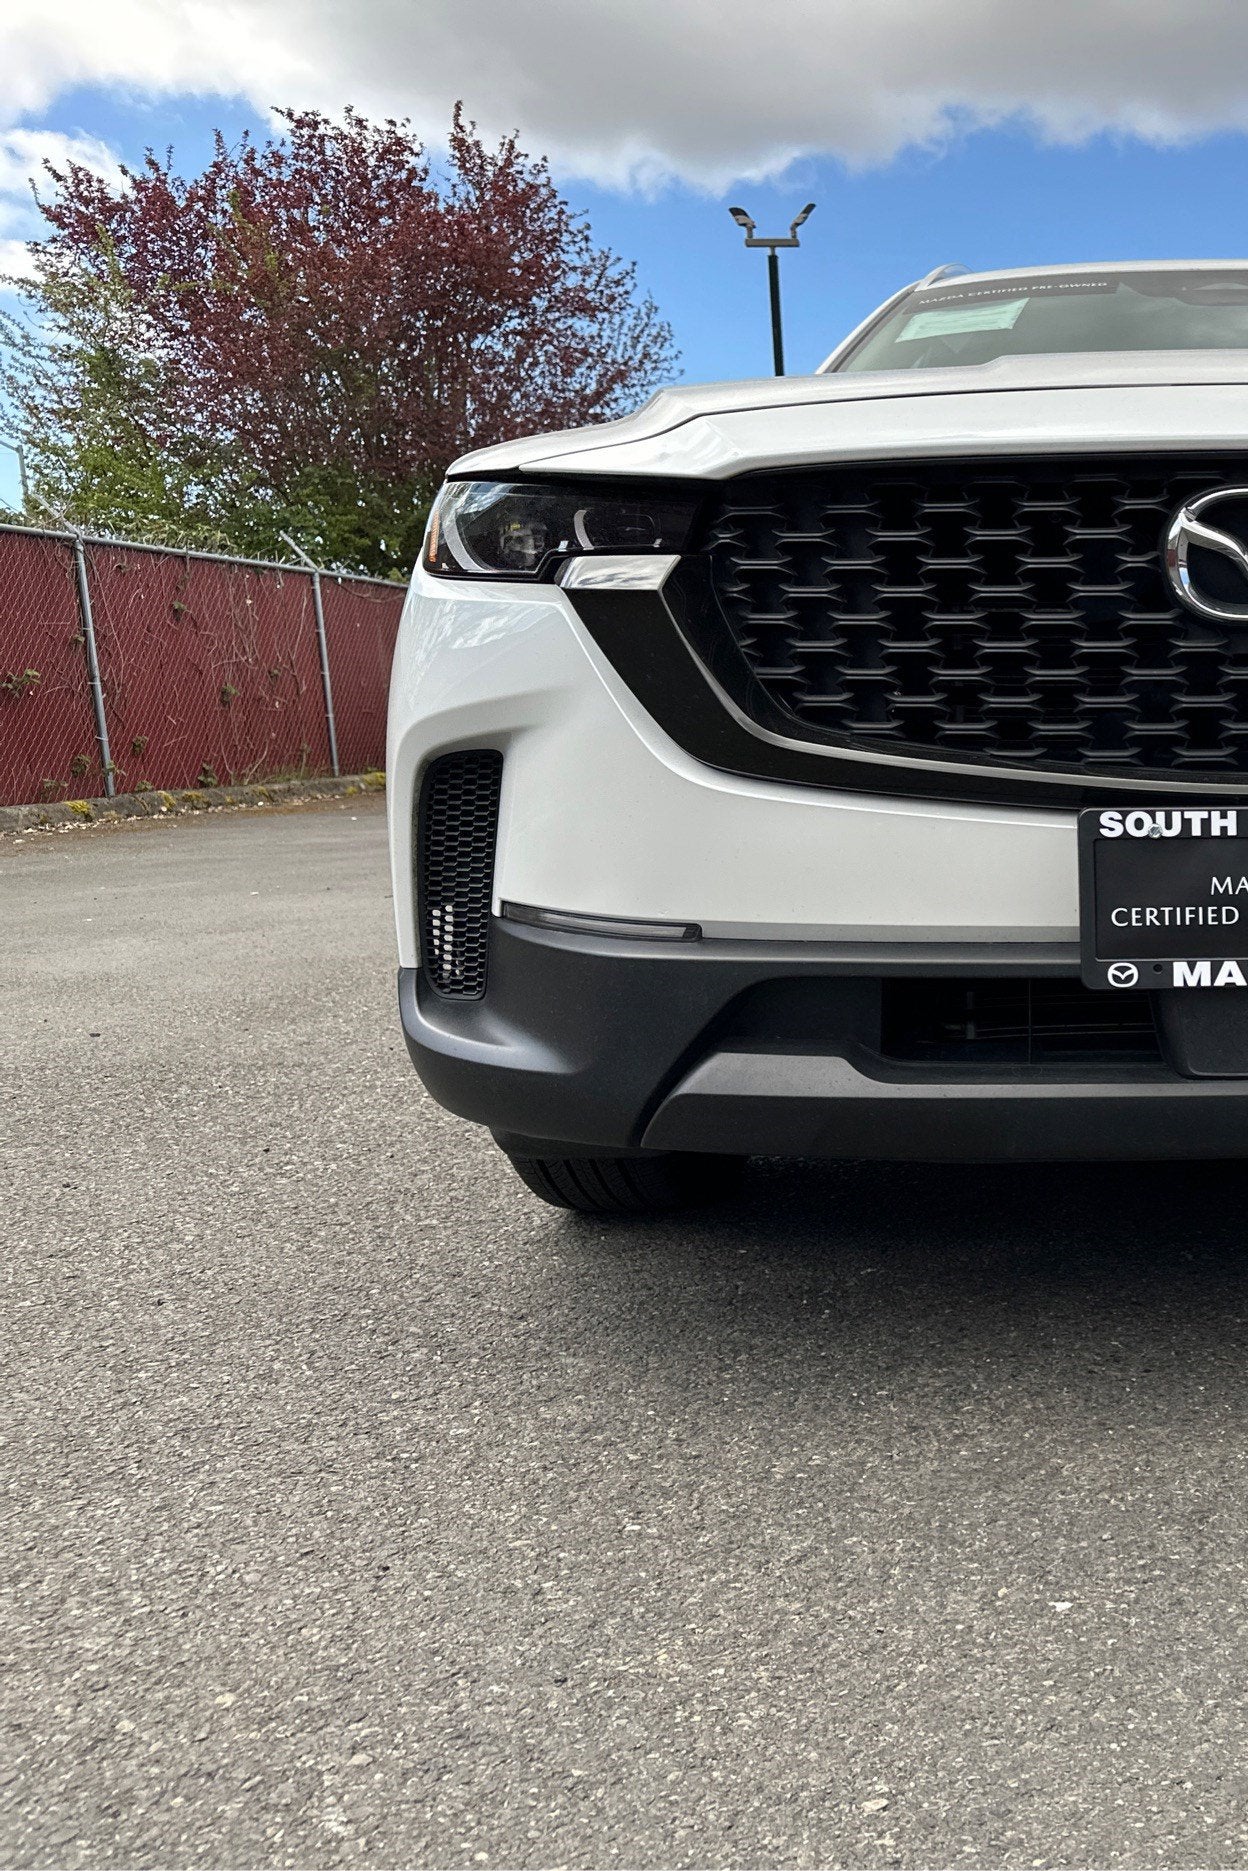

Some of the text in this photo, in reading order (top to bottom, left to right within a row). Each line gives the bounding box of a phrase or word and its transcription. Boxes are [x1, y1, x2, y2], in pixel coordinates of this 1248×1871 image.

[968, 286, 1028, 297] CERTIFIED
[1032, 281, 1107, 290] PRE-OWNED
[1099, 811, 1238, 838] SOUTH
[1110, 906, 1240, 927] CERTIFIED
